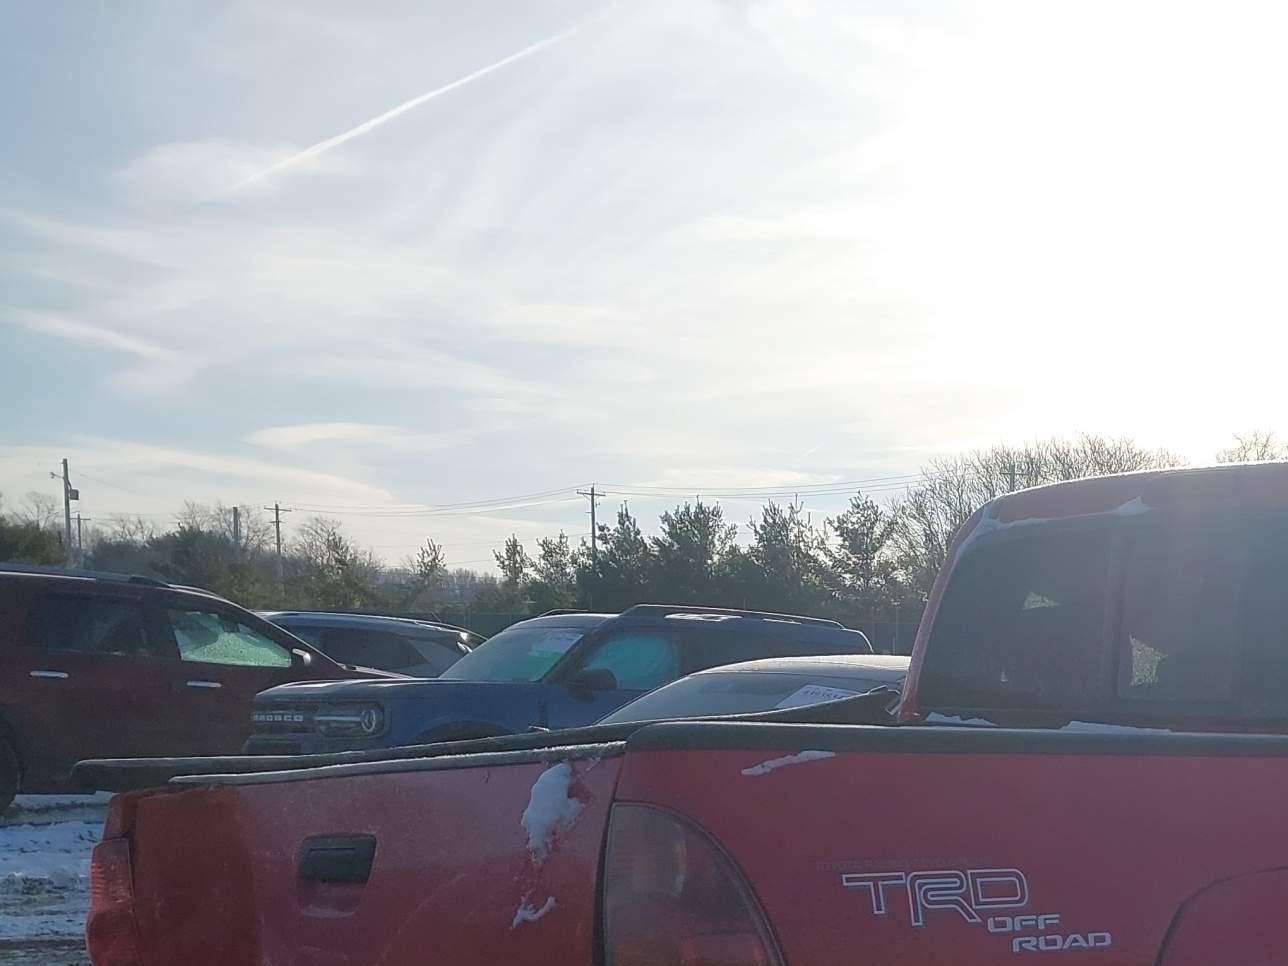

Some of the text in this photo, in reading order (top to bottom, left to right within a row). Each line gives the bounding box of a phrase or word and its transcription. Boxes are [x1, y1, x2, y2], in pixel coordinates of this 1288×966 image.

[842, 868, 1028, 926] TRD
[987, 914, 1060, 933] OFF
[1012, 932, 1112, 952] ROAD
